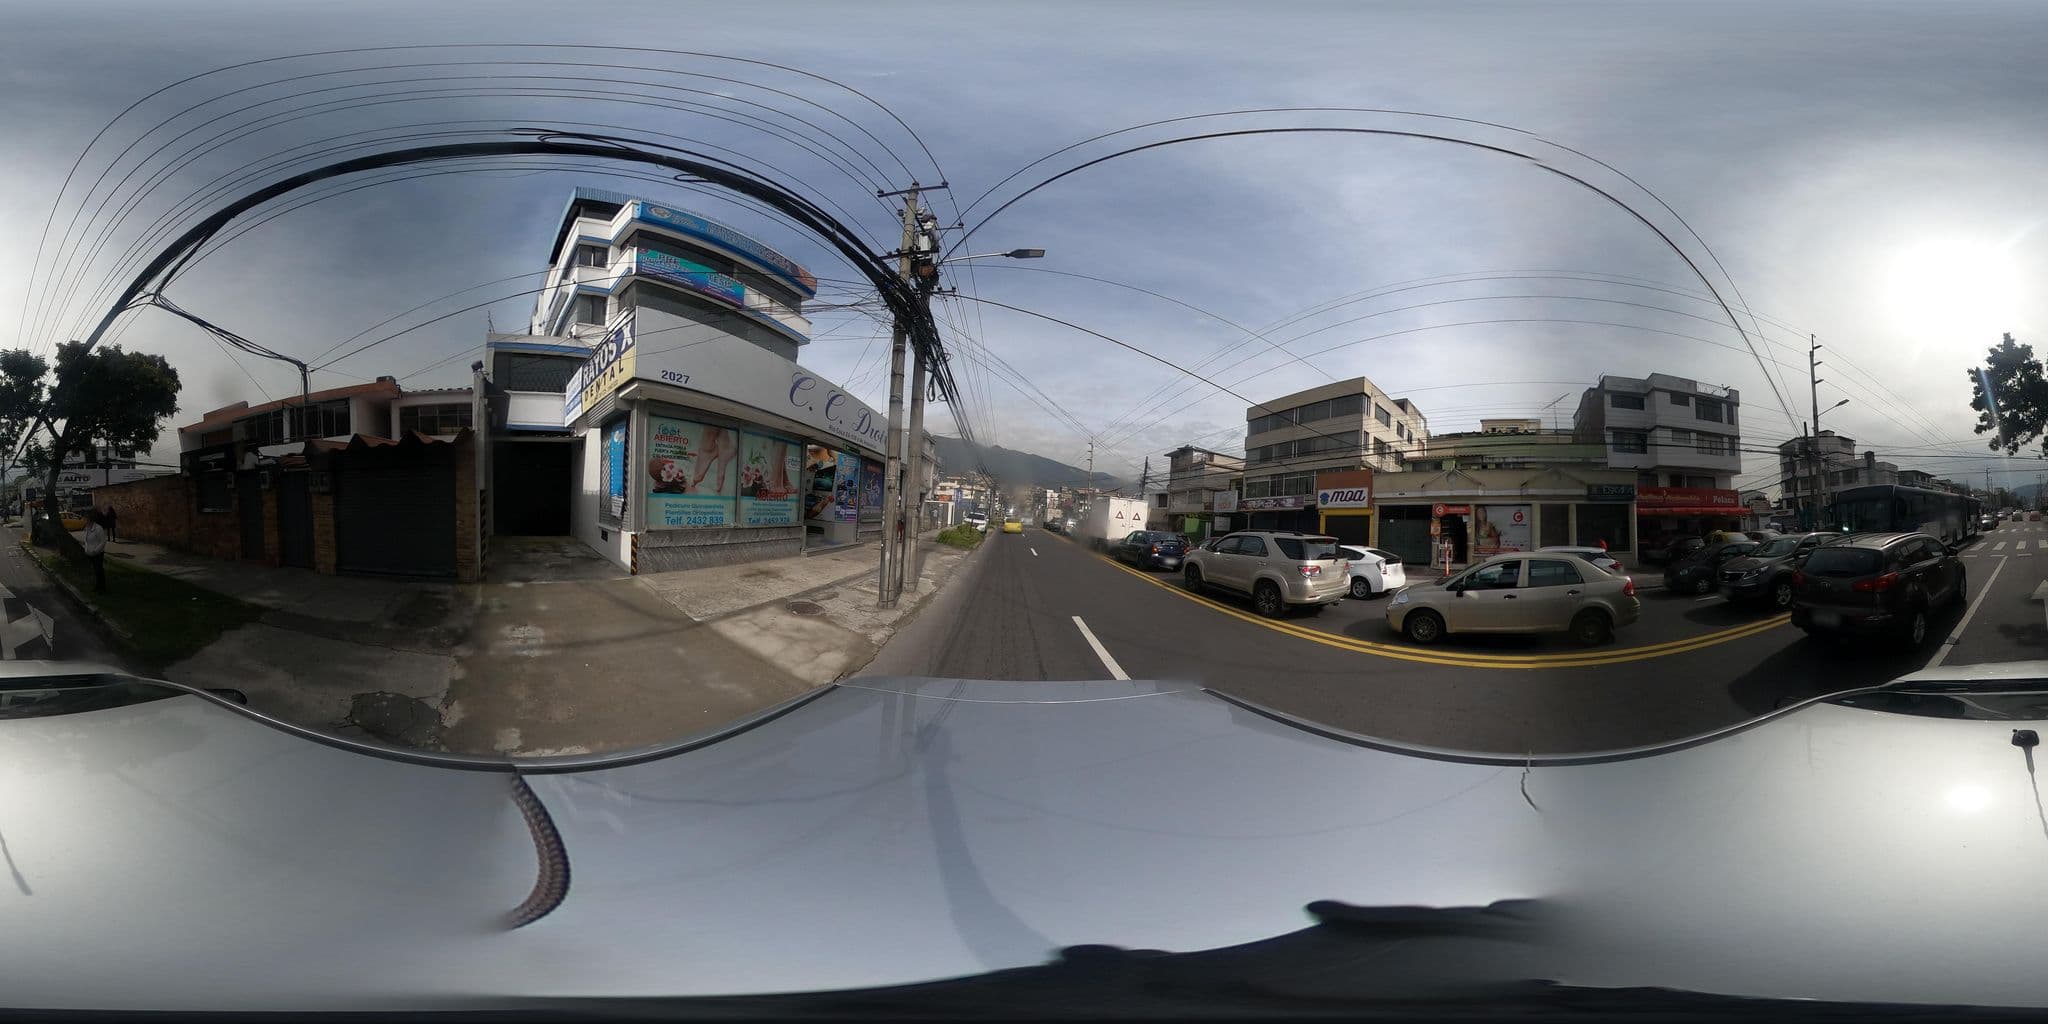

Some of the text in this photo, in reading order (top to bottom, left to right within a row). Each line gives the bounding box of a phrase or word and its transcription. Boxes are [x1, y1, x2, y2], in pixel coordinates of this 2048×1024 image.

[582, 321, 633, 389] RAYOS X
[584, 356, 625, 402] DENTAL
[661, 369, 691, 385] 2027
[654, 434, 689, 445] ABIERTO
[1330, 490, 1366, 502] moa
